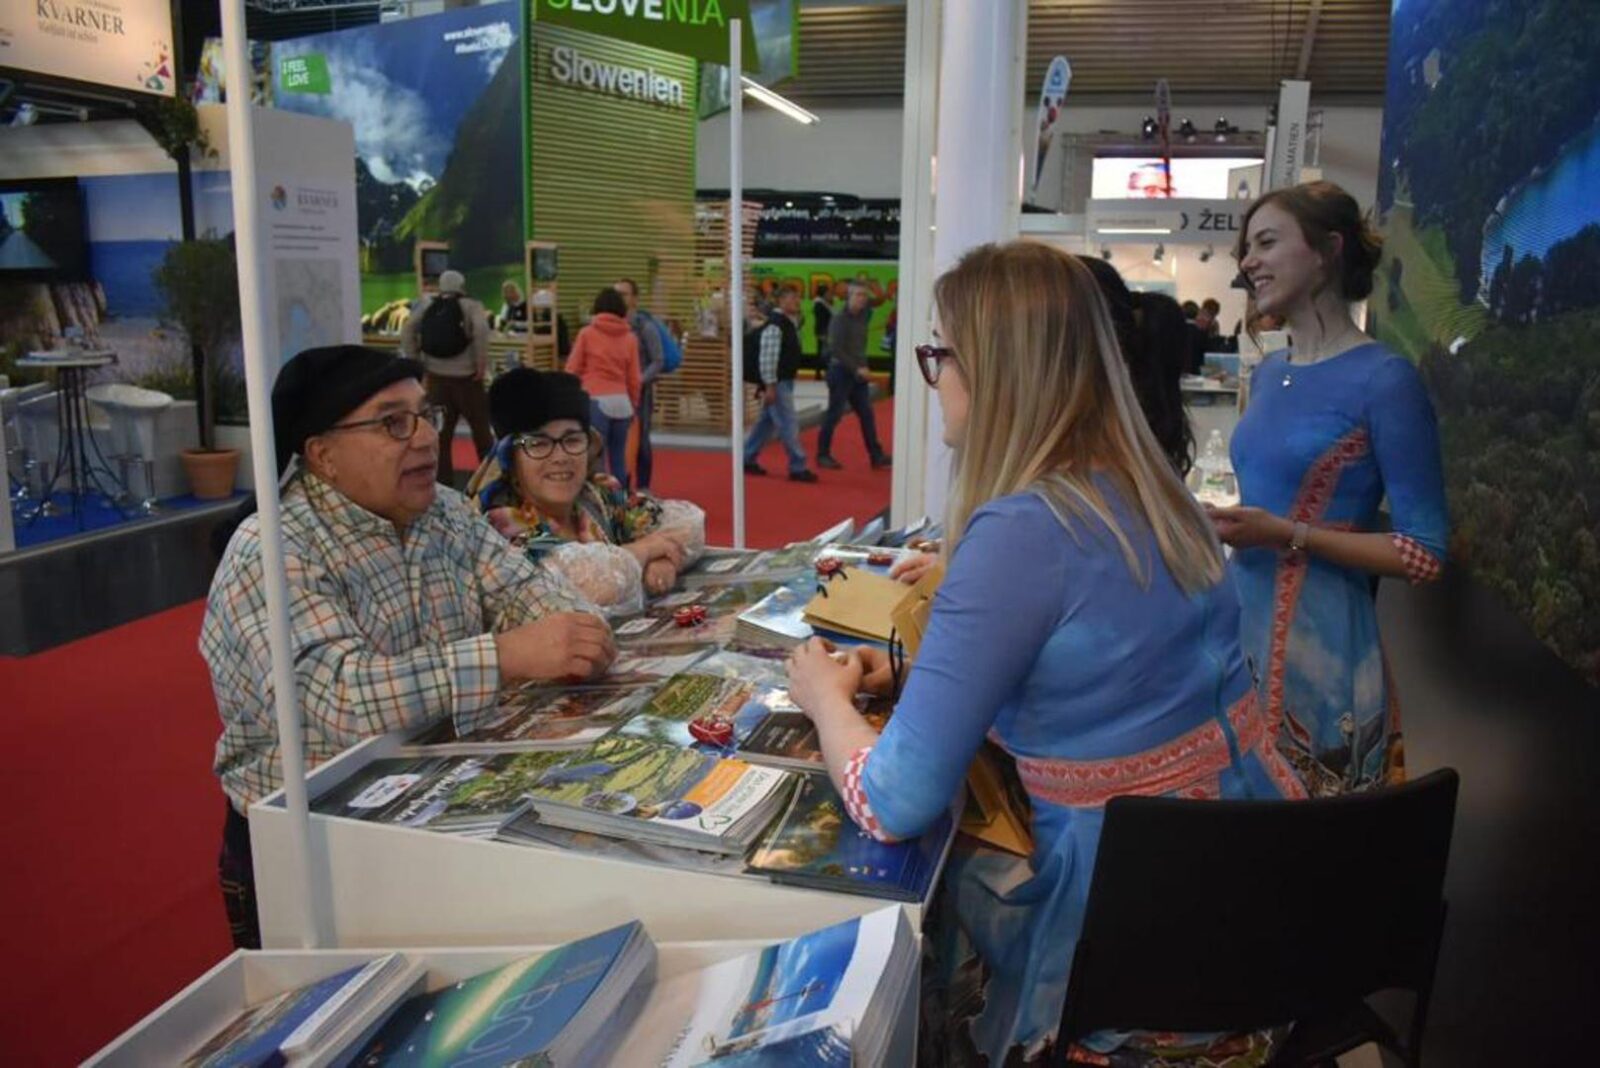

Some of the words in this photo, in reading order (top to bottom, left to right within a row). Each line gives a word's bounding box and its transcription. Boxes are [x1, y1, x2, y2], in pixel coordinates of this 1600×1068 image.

[37, 0, 125, 35] KVARNER
[547, 0, 724, 27] VENIA
[551, 46, 683, 105] Slowenien
[1197, 207, 1243, 232] ŽEL
